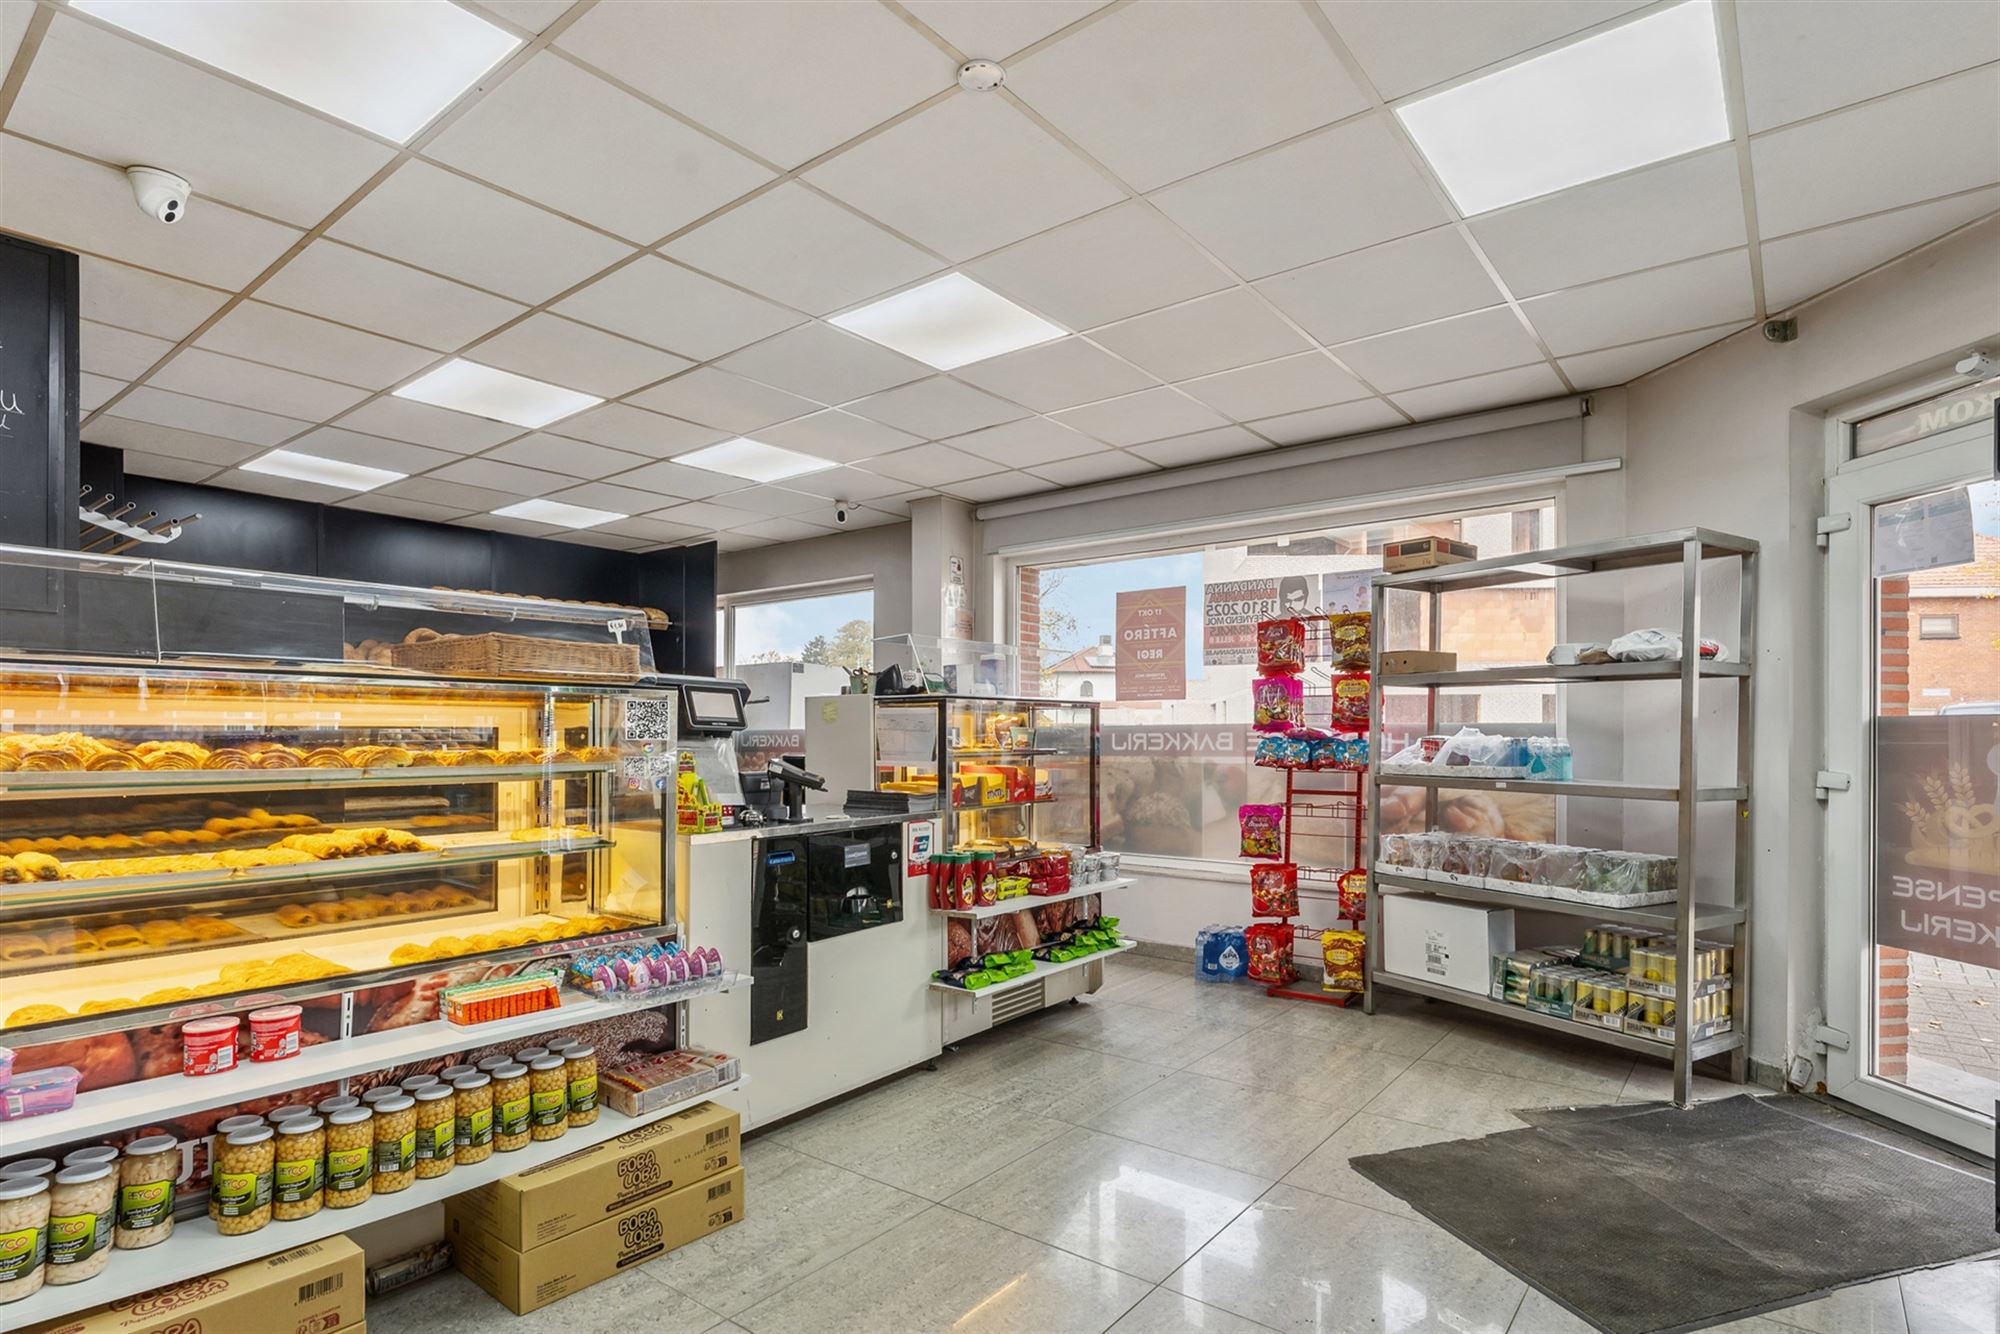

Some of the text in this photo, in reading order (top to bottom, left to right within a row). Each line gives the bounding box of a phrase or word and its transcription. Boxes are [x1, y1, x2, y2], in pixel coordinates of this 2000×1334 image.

[1222, 952, 1238, 960] SPA
[617, 1149, 656, 1178] BOBA
[623, 1163, 661, 1190] LOBA
[618, 1207, 658, 1236] BOBA
[624, 1222, 664, 1249] LOBA
[131, 1278, 229, 1316] LOBA
